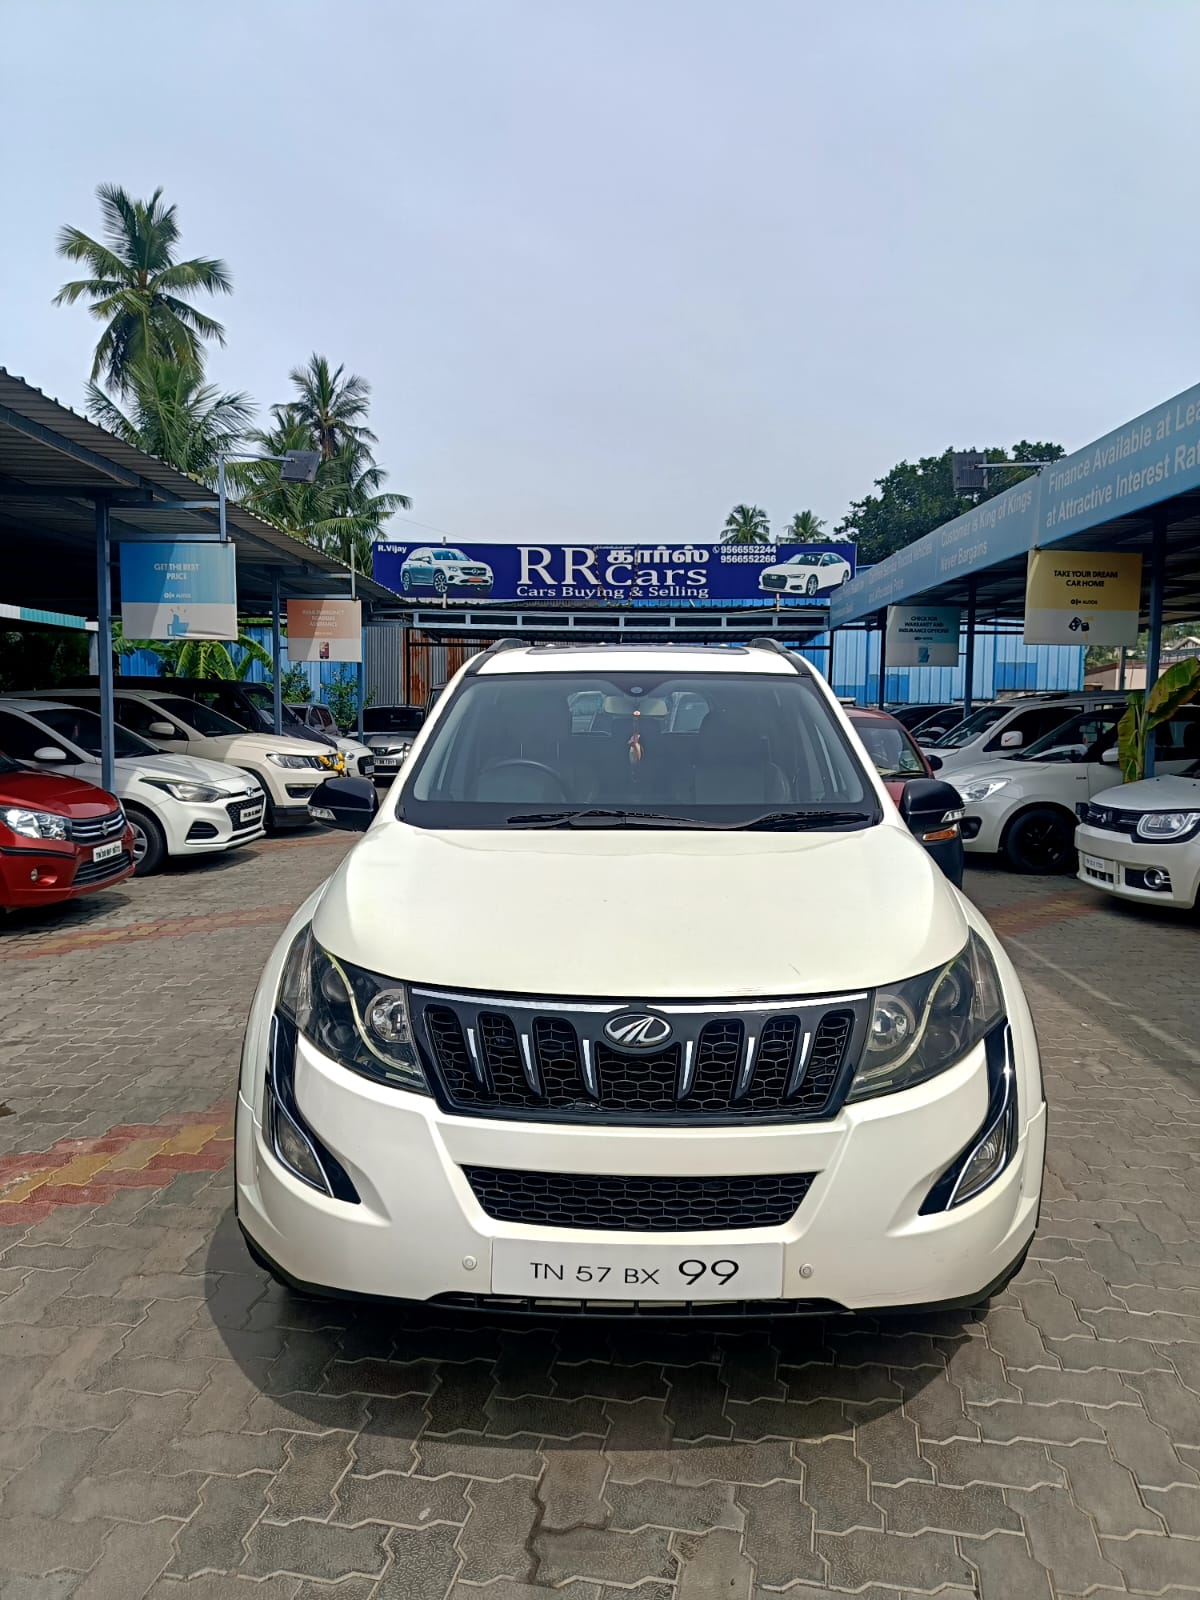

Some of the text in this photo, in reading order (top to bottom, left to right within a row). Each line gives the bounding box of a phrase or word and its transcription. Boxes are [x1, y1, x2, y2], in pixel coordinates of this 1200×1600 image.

[1049, 458, 1090, 494] Finance
[1092, 424, 1152, 474] Available
[1156, 411, 1171, 441] at
[1046, 509, 1056, 528] at
[1057, 483, 1112, 522] Attractive
[1116, 453, 1170, 499] Interest
[980, 511, 996, 529] King
[998, 503, 1007, 520] of
[1008, 490, 1032, 514] Kings
[377, 545, 407, 554] R.Vijay
[606, 545, 710, 564] கார்ஸ்
[720, 545, 777, 554] 9566552244
[720, 555, 777, 563] 9566552266
[516, 546, 601, 585] RR
[605, 564, 707, 586] Cars
[1054, 570, 1070, 578] TAKE
[1071, 570, 1091, 578] YOUR
[516, 586, 710, 599] Cars Buying & Selling
[530, 1259, 739, 1285] TN 57 BX 99
